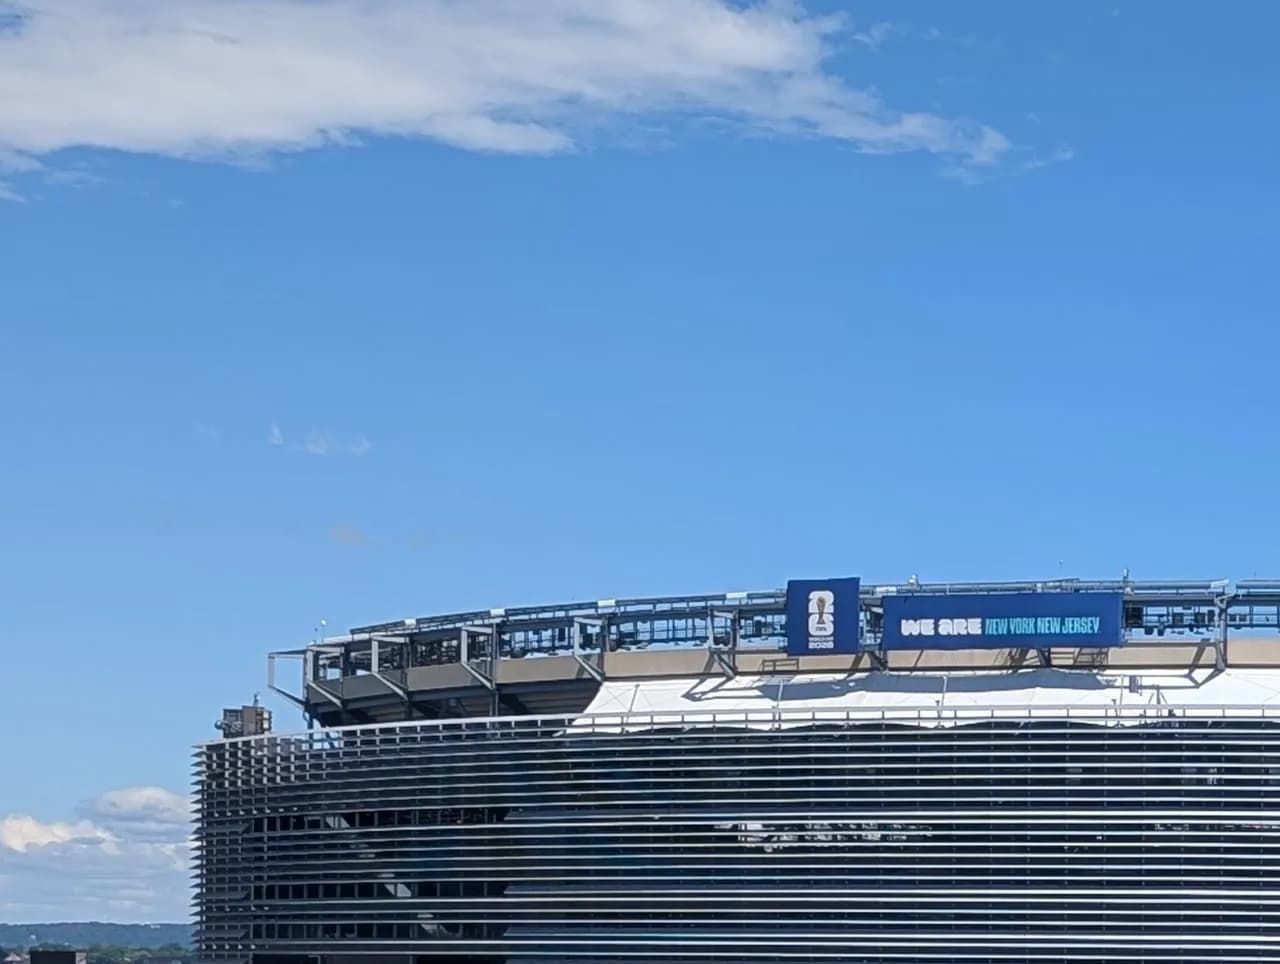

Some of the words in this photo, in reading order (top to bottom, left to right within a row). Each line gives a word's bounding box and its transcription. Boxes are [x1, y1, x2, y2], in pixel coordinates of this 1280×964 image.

[901, 618, 935, 636] WE
[938, 618, 982, 635] ARE
[985, 618, 1008, 635] NEW
[1009, 617, 1035, 634] YORK
[1037, 617, 1060, 634] NEW
[1062, 616, 1100, 634] JERSEY
